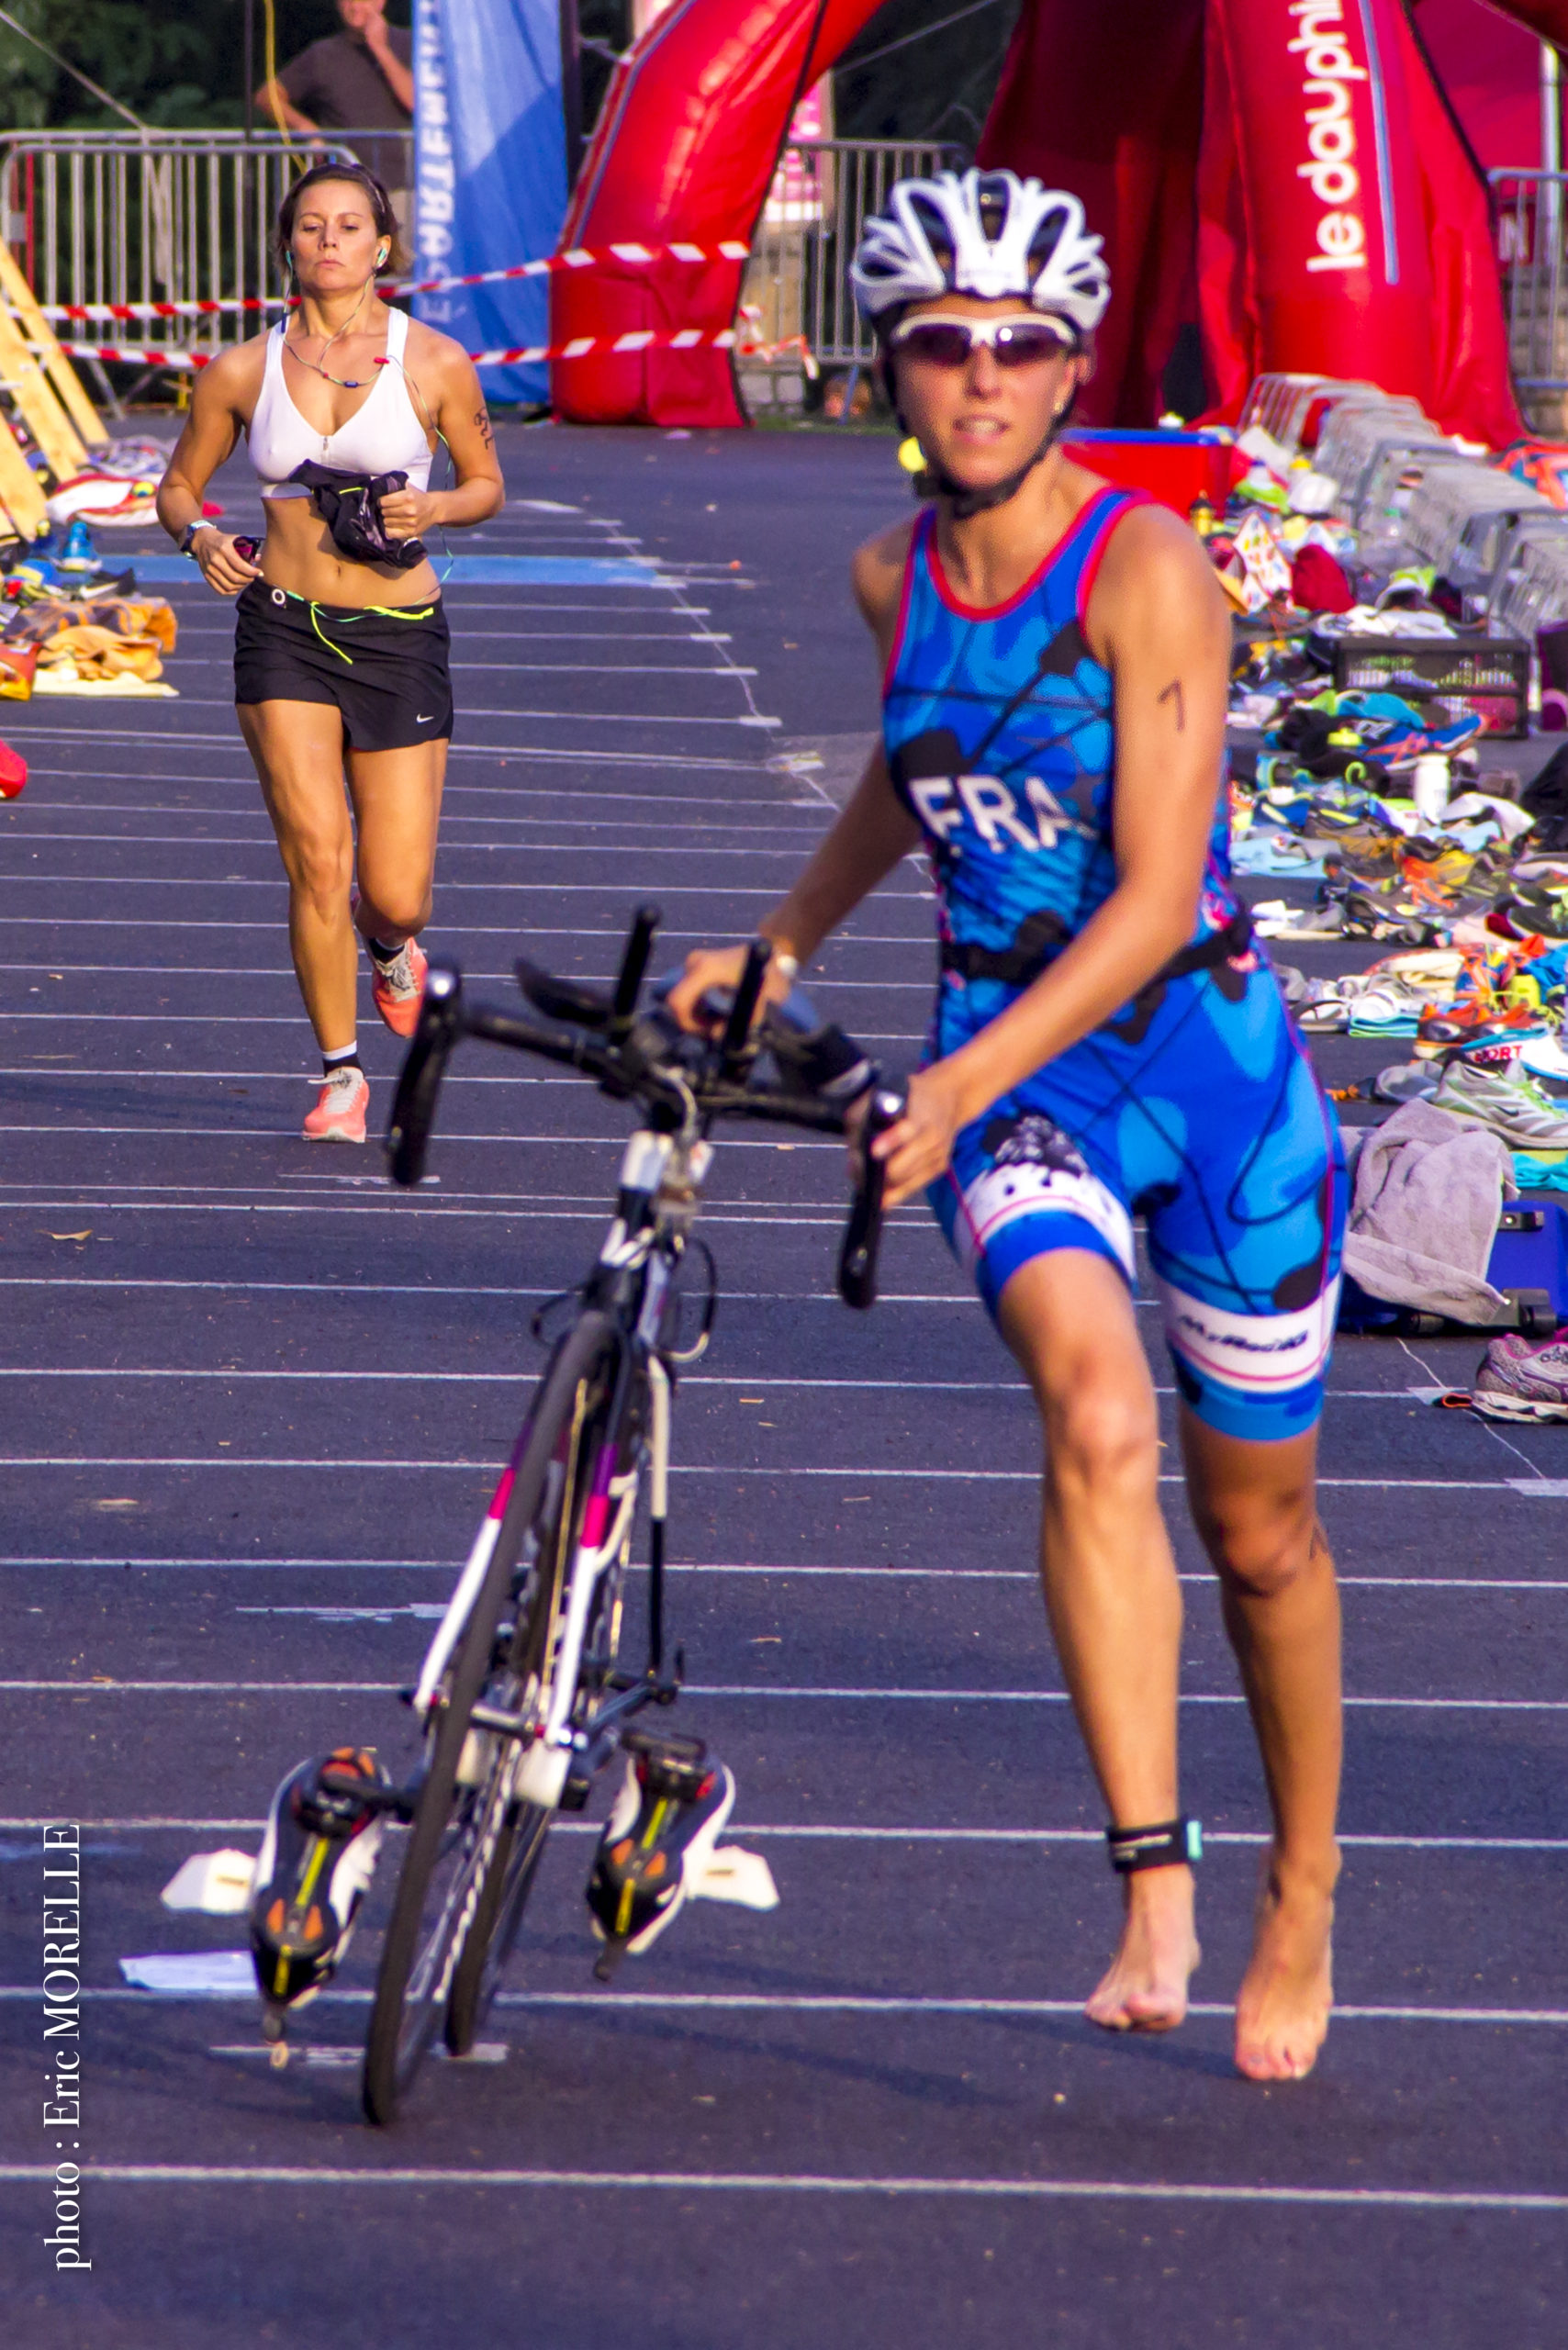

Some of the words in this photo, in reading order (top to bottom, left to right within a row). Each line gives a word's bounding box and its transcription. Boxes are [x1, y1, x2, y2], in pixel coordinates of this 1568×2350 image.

[1287, 0, 1368, 205] dauphi
[1305, 212, 1366, 272] le
[907, 775, 1100, 854] FRA
